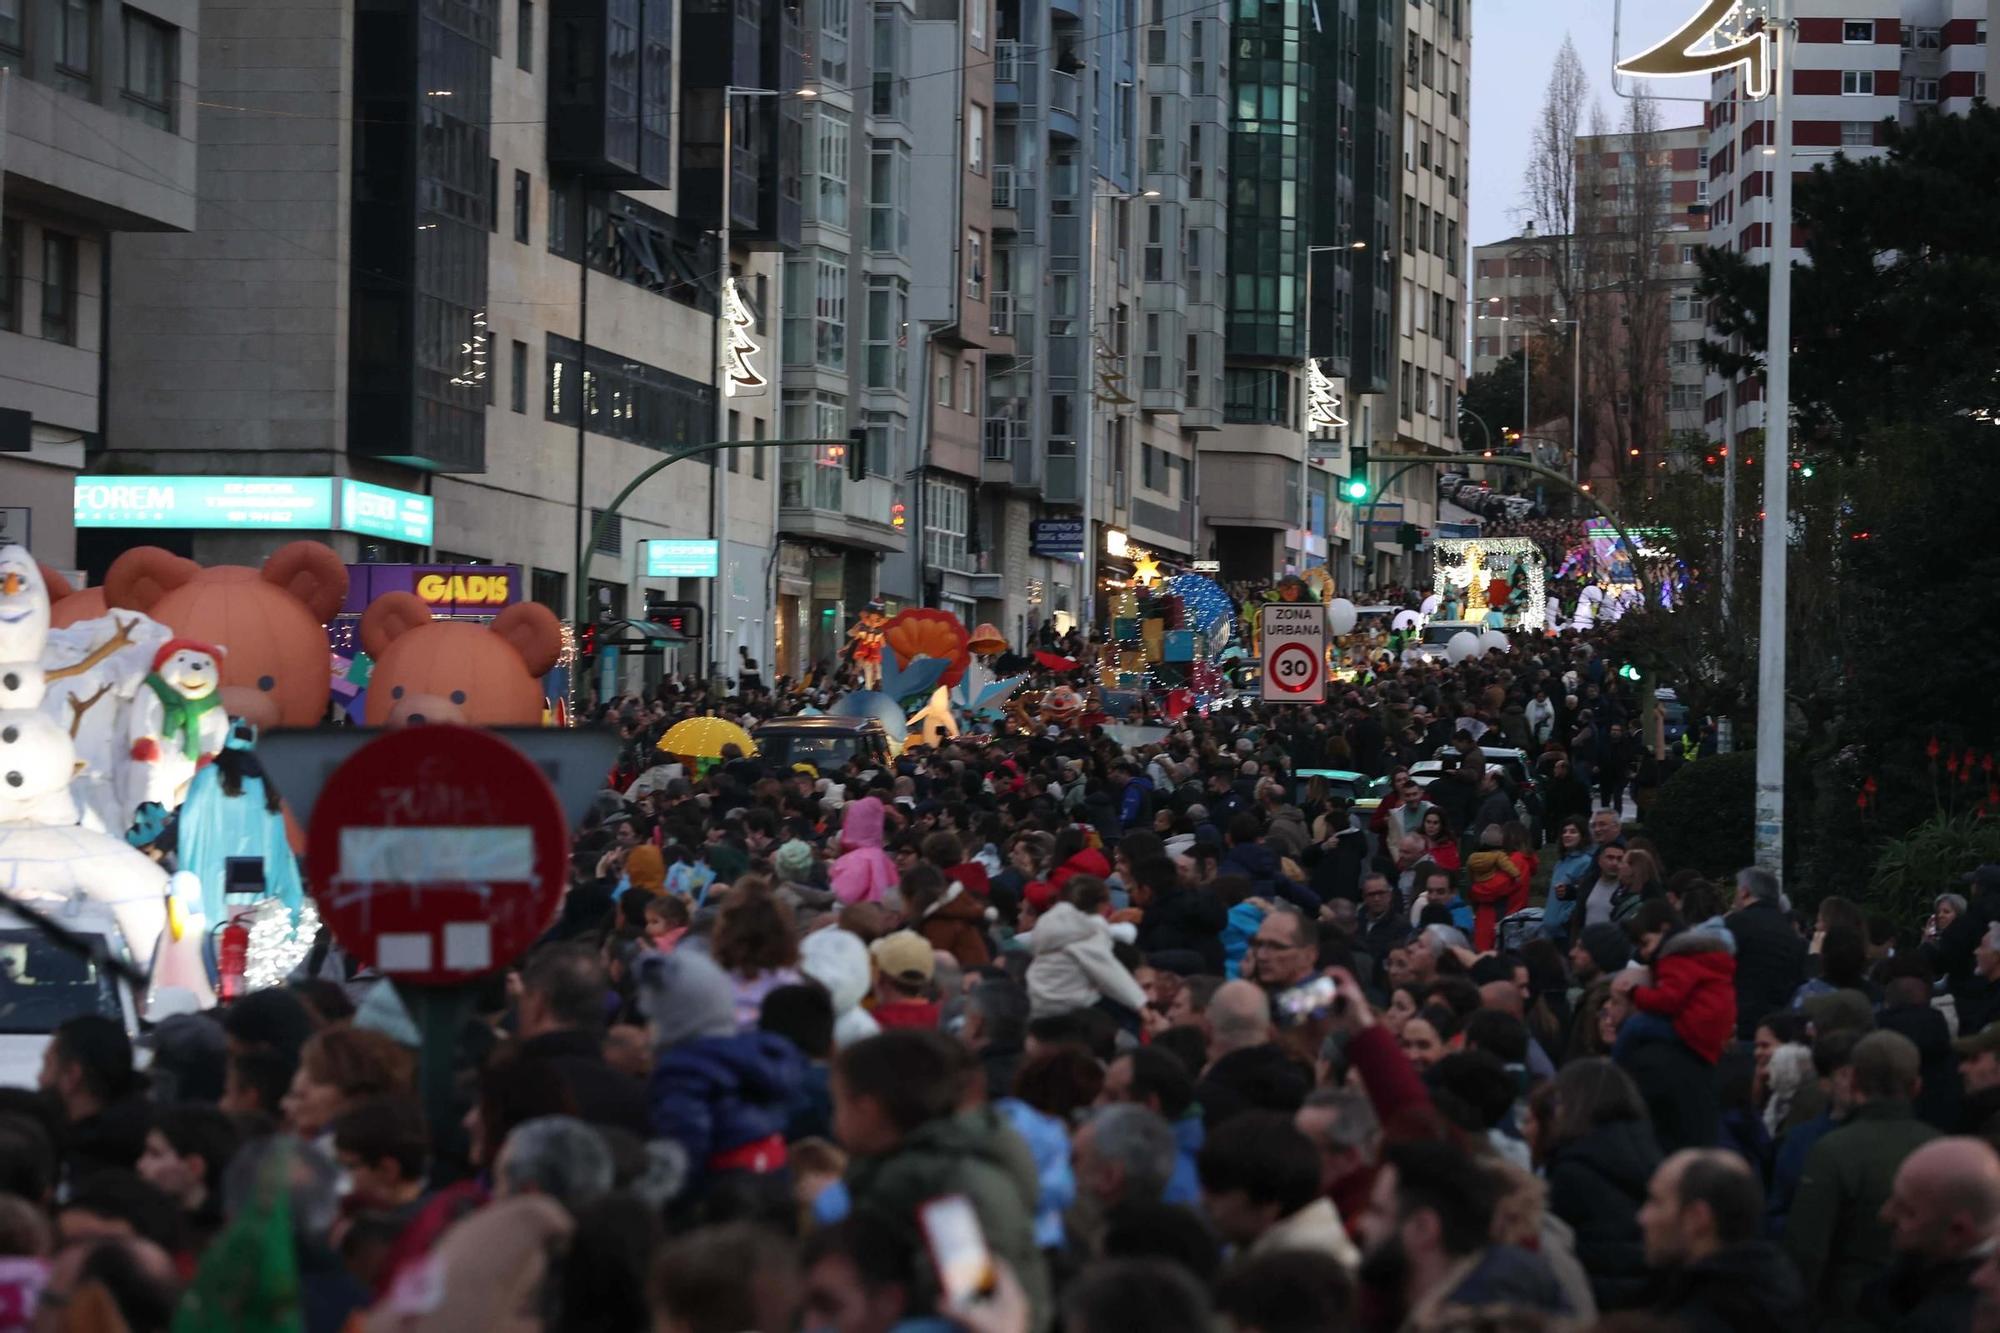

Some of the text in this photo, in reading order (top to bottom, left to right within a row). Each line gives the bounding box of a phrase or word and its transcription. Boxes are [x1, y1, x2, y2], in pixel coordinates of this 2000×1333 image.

[417, 574, 508, 604] GADIS
[1275, 608, 1313, 620] ZONA
[1266, 624, 1322, 636] URBANA
[1280, 659, 1308, 677] 30
